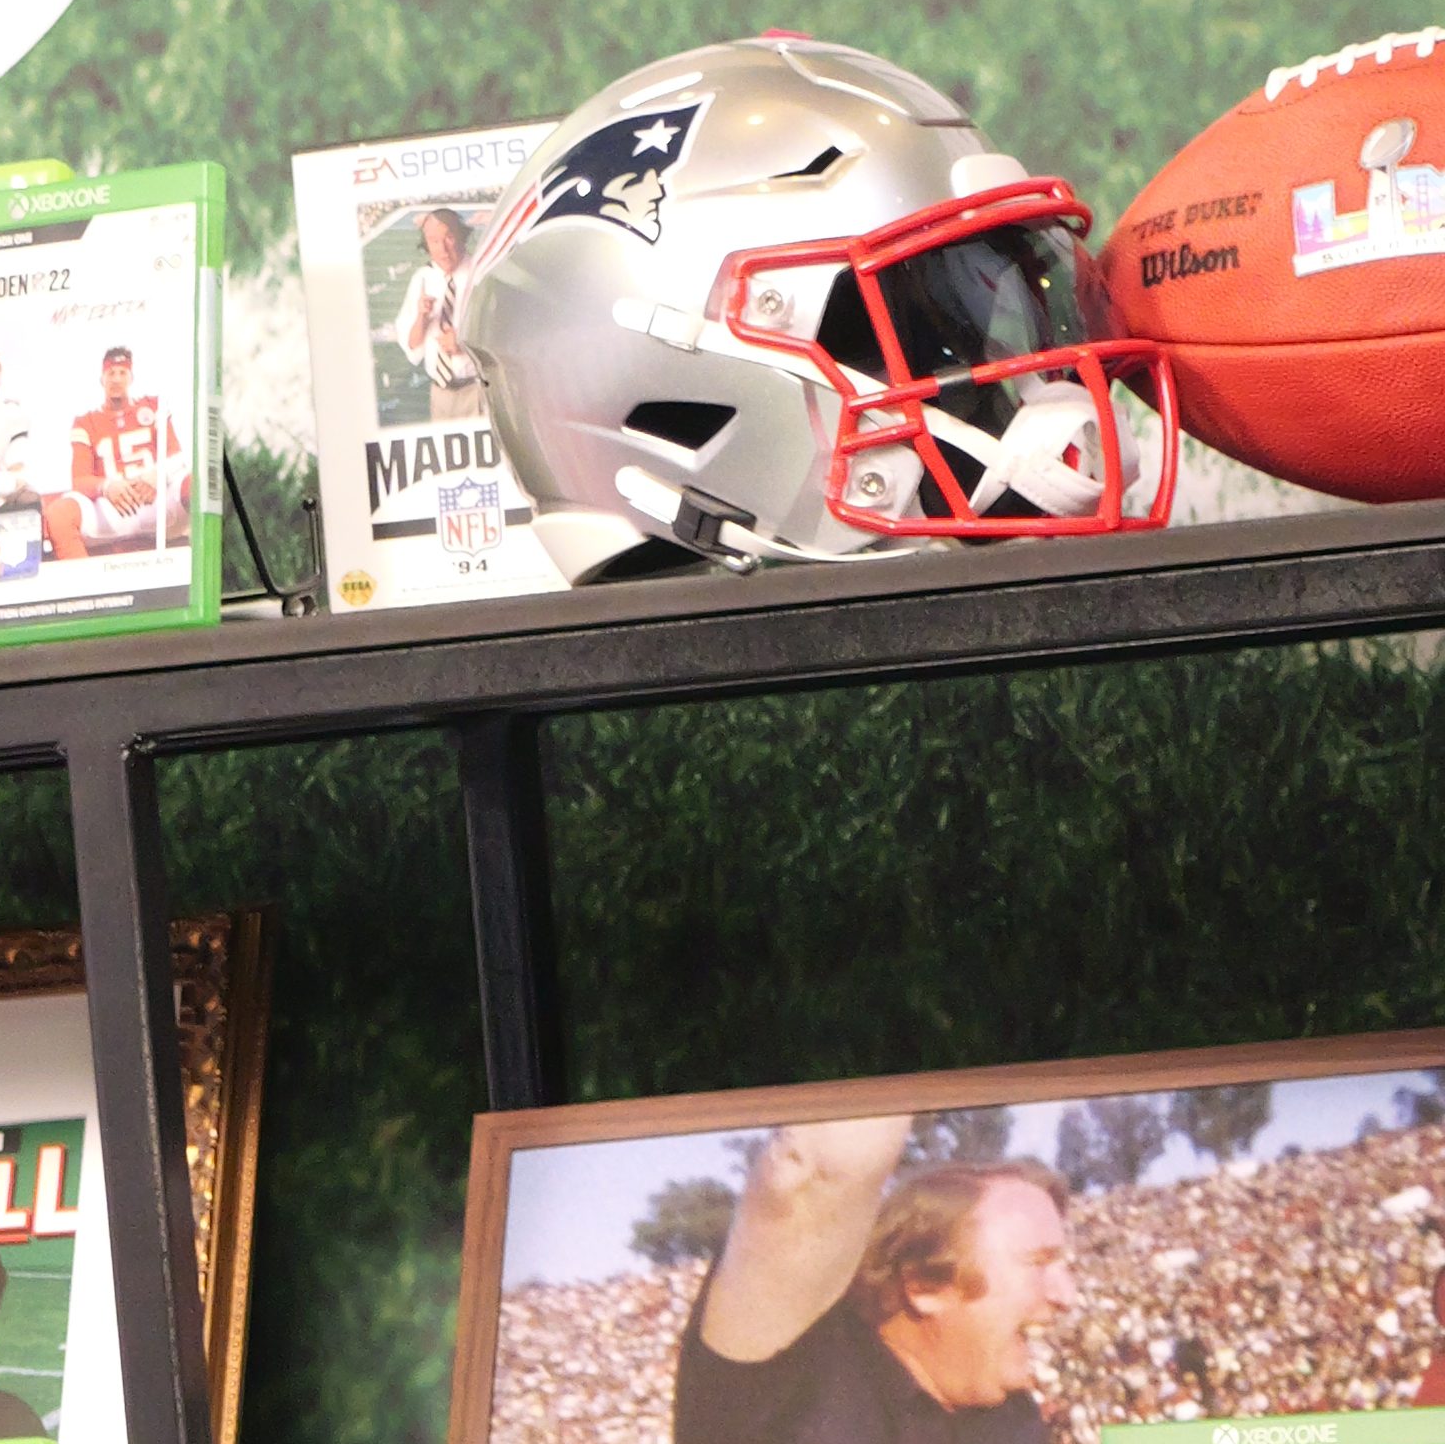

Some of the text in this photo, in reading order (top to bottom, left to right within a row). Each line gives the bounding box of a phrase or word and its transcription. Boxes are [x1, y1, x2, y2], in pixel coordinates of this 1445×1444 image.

[400, 138, 528, 178] SPORTS
[29, 183, 111, 215] XBOX ONE
[48, 268, 71, 292] 22
[1140, 241, 1241, 289] Wilson
[445, 512, 499, 549] NFL
[1294, 1423, 1338, 1444] ONE
